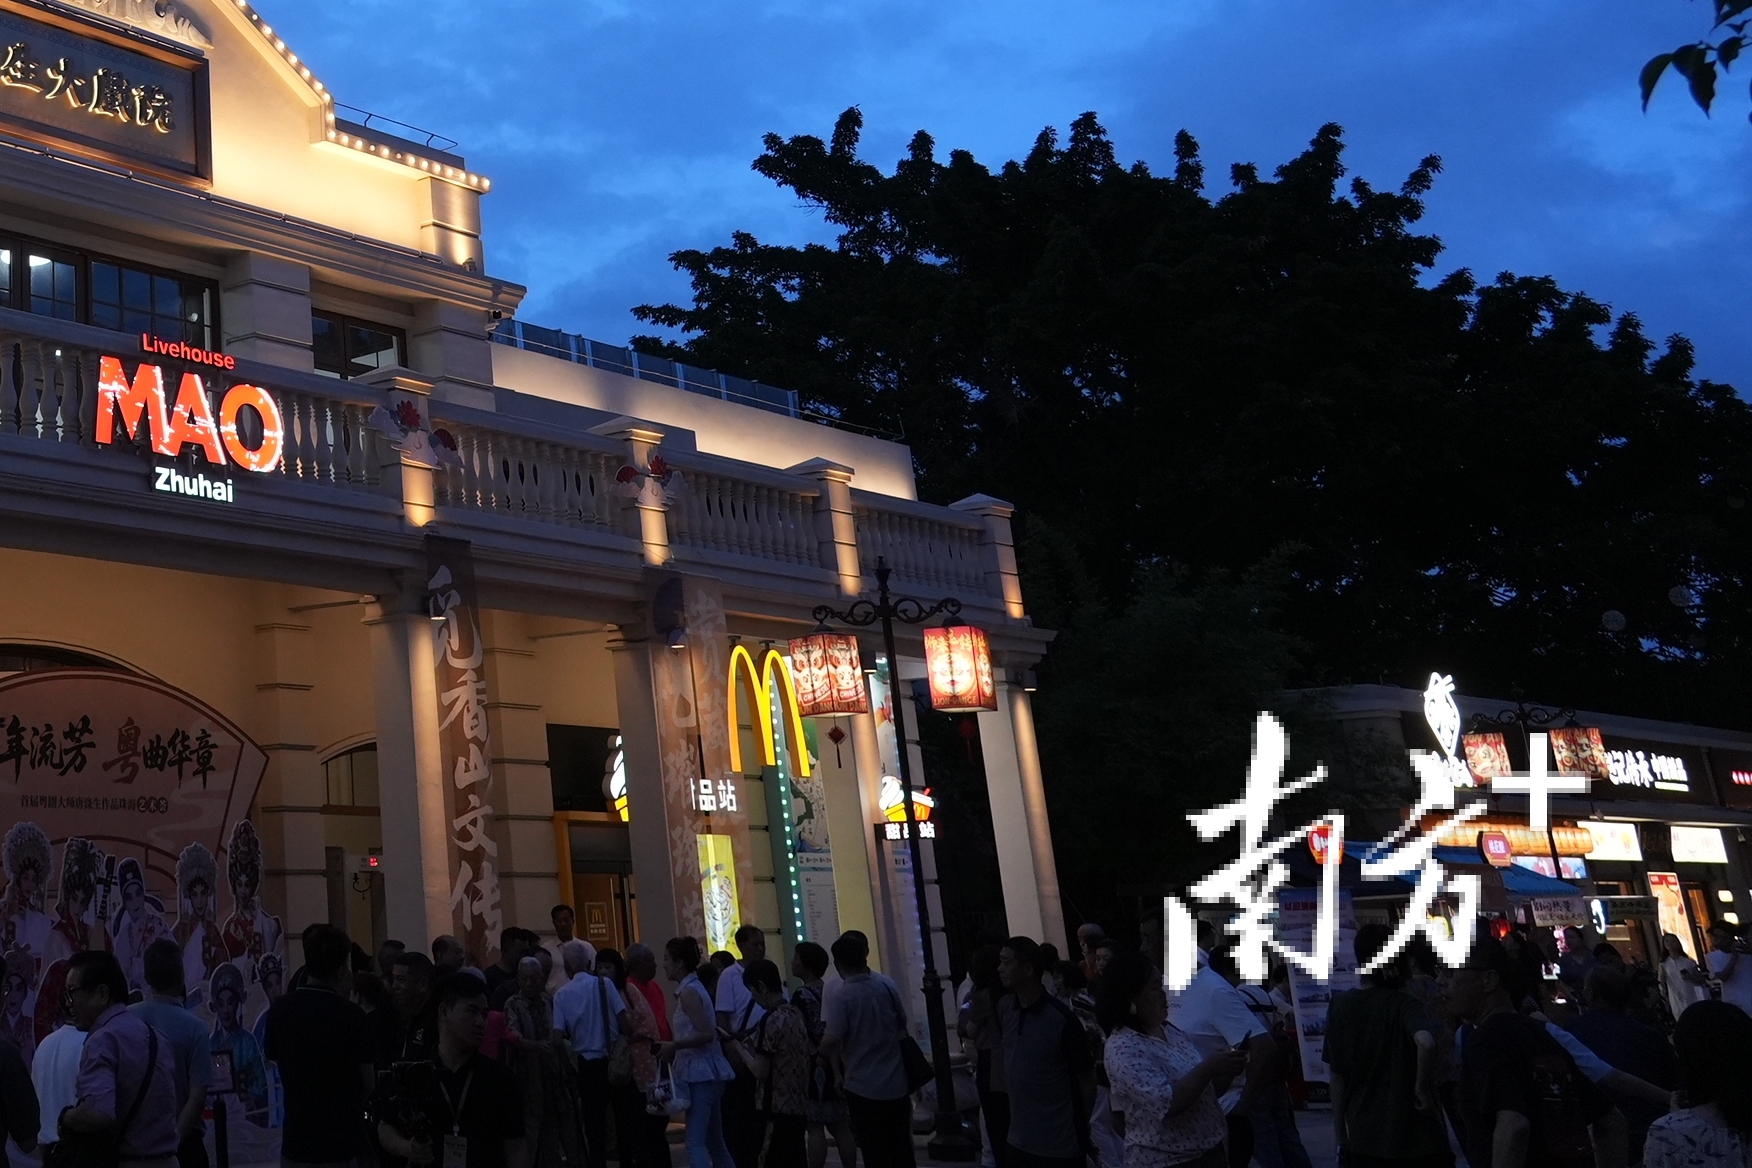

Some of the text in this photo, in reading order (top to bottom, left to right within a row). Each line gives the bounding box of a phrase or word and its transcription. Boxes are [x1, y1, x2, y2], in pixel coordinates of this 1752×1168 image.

[142, 333, 236, 370] Livehouse
[95, 355, 284, 473] MAO
[154, 466, 234, 503] Zhuhai
[102, 716, 219, 789] 粤曲华章
[689, 777, 737, 812] 品站
